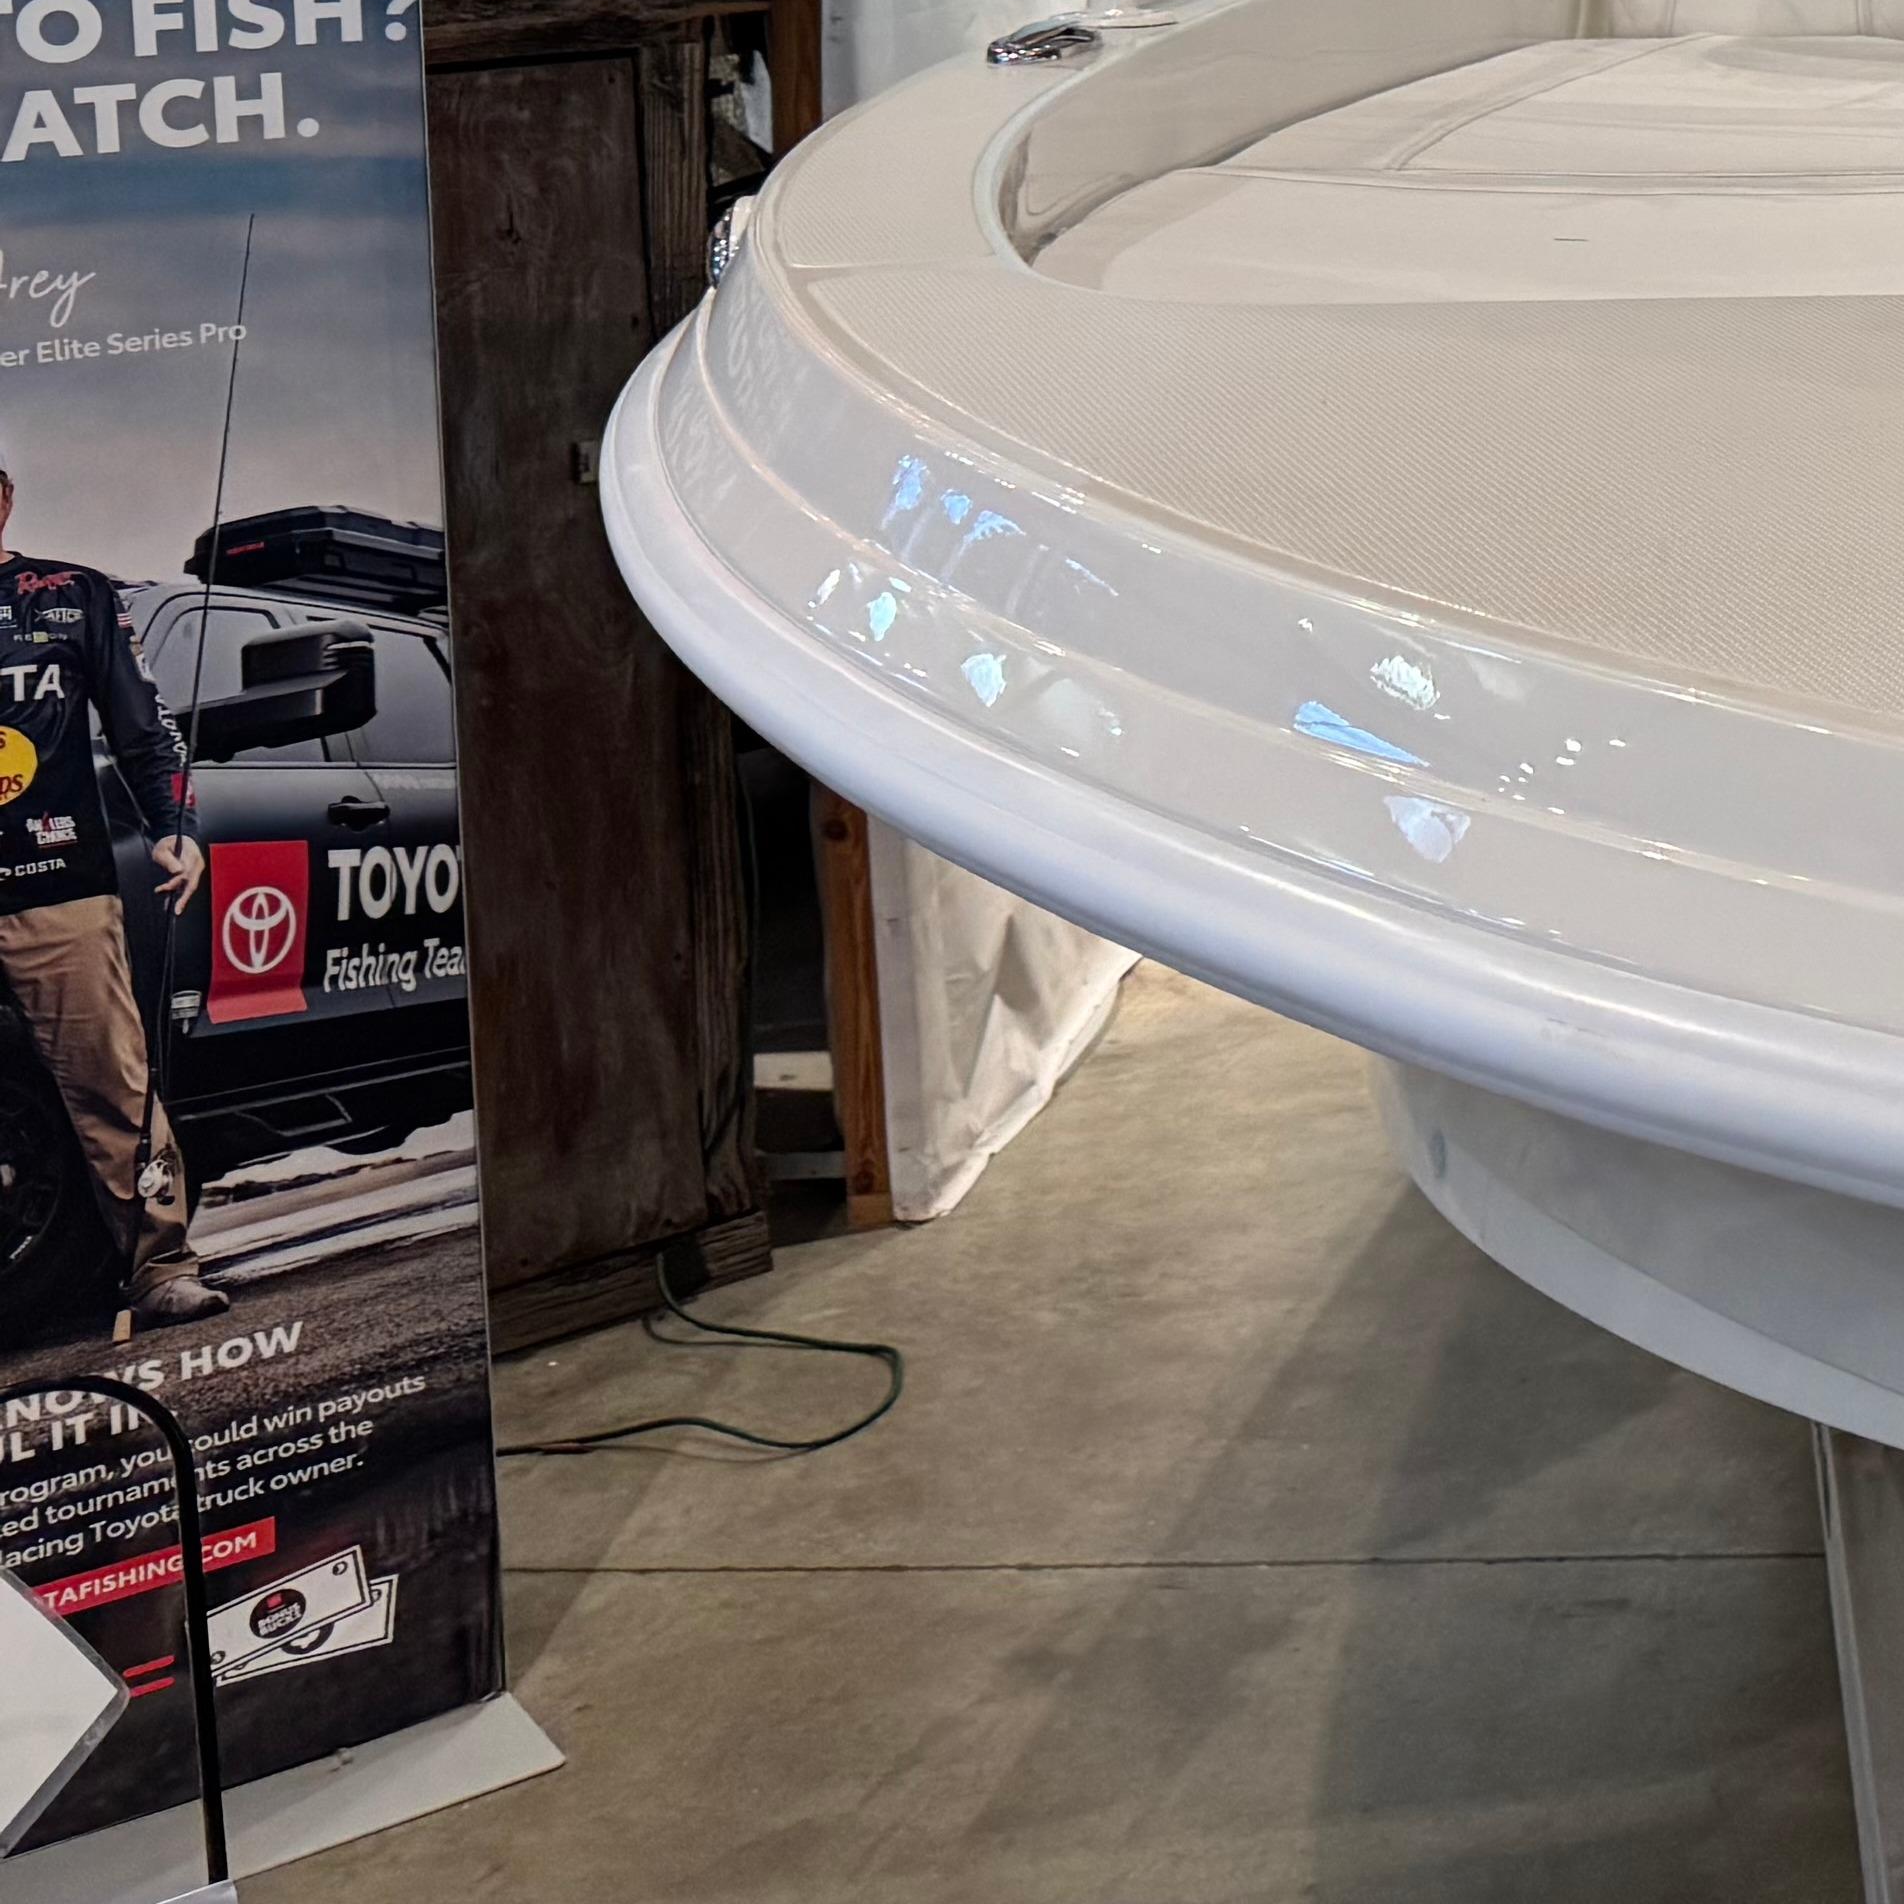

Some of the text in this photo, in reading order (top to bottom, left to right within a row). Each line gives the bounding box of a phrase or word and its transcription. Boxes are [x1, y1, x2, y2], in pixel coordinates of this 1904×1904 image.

[0, 249, 97, 328] rey
[36, 338, 101, 364] Elite
[106, 328, 194, 356] Series
[200, 322, 248, 345] Pro
[14, 857, 67, 878] COSTA
[328, 843, 463, 922] TOYO
[323, 942, 418, 994] Fishing
[180, 1321, 304, 1382] HOW
[51, 1411, 95, 1452] IT
[119, 1447, 174, 1478] you
[187, 1415, 258, 1452] ould
[263, 1404, 313, 1434] win
[318, 1374, 427, 1424] payouts
[0, 1506, 39, 1538] ed
[235, 1431, 324, 1472] across
[327, 1418, 375, 1444] the
[0, 1531, 84, 1569] acing
[197, 1477, 266, 1514] truck
[269, 1451, 365, 1492] owner.
